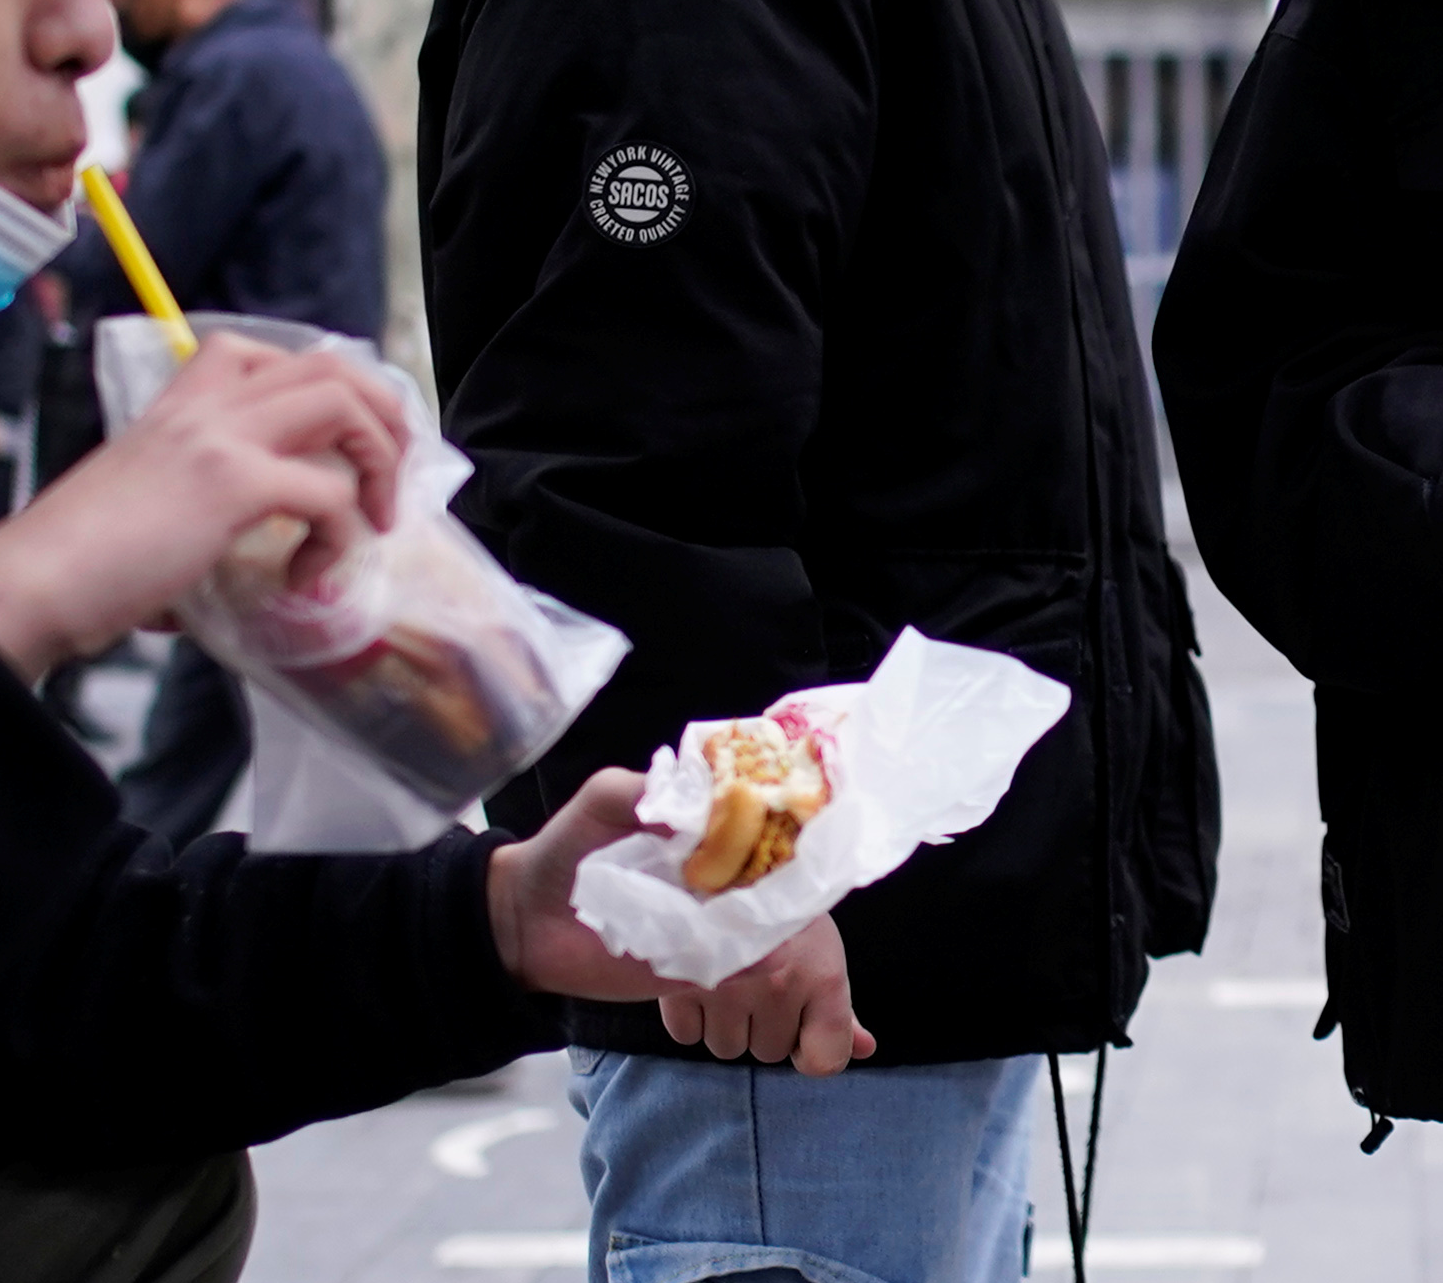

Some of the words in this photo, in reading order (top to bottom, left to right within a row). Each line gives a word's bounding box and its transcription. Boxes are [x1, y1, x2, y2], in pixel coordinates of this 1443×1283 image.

[607, 180, 670, 209] SACOS
[650, 148, 689, 201] VINTAGE
[589, 198, 635, 242] CRAFTED
[639, 204, 686, 244] QUALITY
